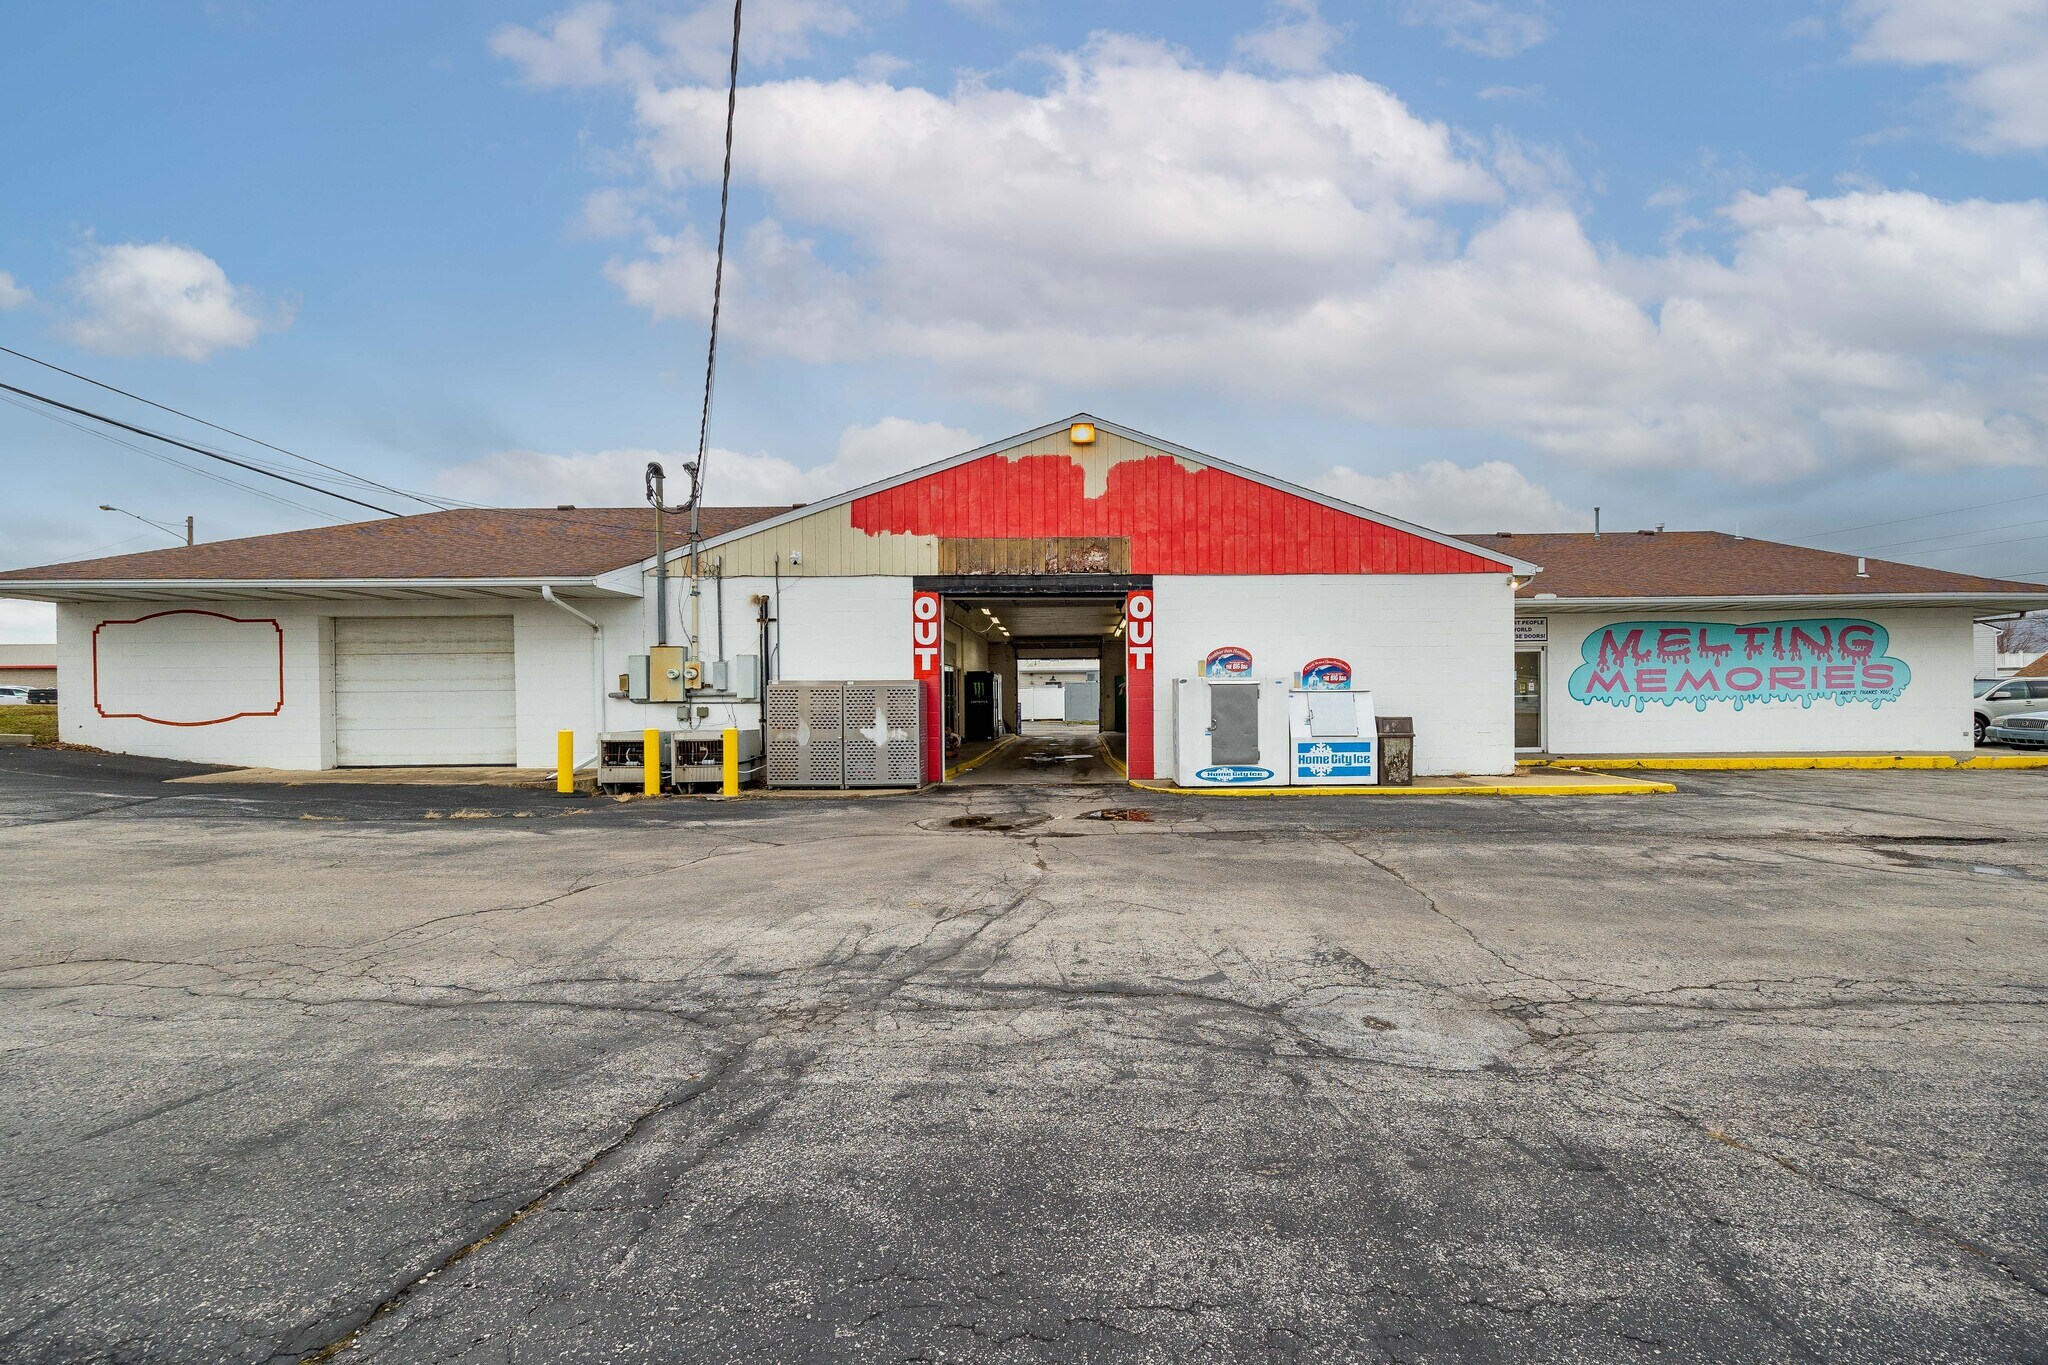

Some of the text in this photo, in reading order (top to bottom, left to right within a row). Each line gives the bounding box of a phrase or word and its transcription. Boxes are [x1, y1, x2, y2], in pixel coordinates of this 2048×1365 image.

[914, 596, 938, 671] OUT
[1129, 595, 1152, 670] OUT
[1597, 625, 1875, 673] MELTING
[1585, 664, 1895, 693] MEMORIES
[1880, 687, 1894, 695] YOU!
[1298, 755, 1371, 766] Home City Ice
